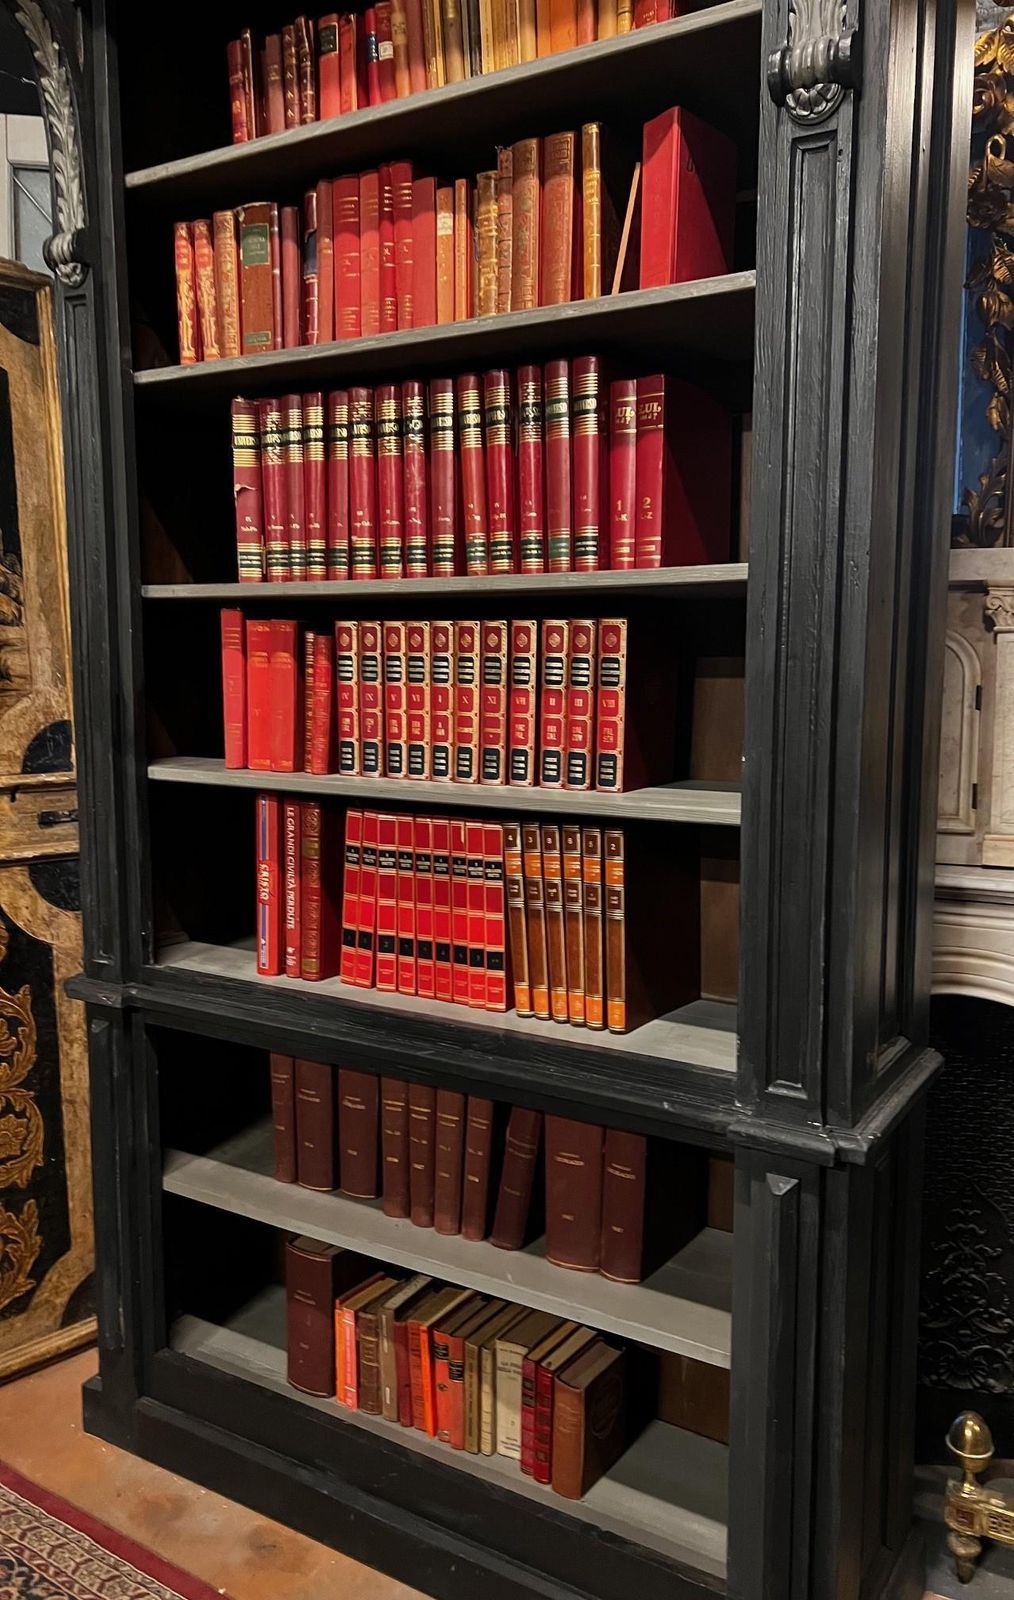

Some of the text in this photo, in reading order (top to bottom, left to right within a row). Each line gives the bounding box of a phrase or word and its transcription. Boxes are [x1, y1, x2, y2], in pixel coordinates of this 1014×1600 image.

[286, 807, 295, 817] LE
[286, 818, 295, 855] GRANDI
[259, 864, 270, 901] CRISTO
[286, 890, 295, 929] PERDUTE
